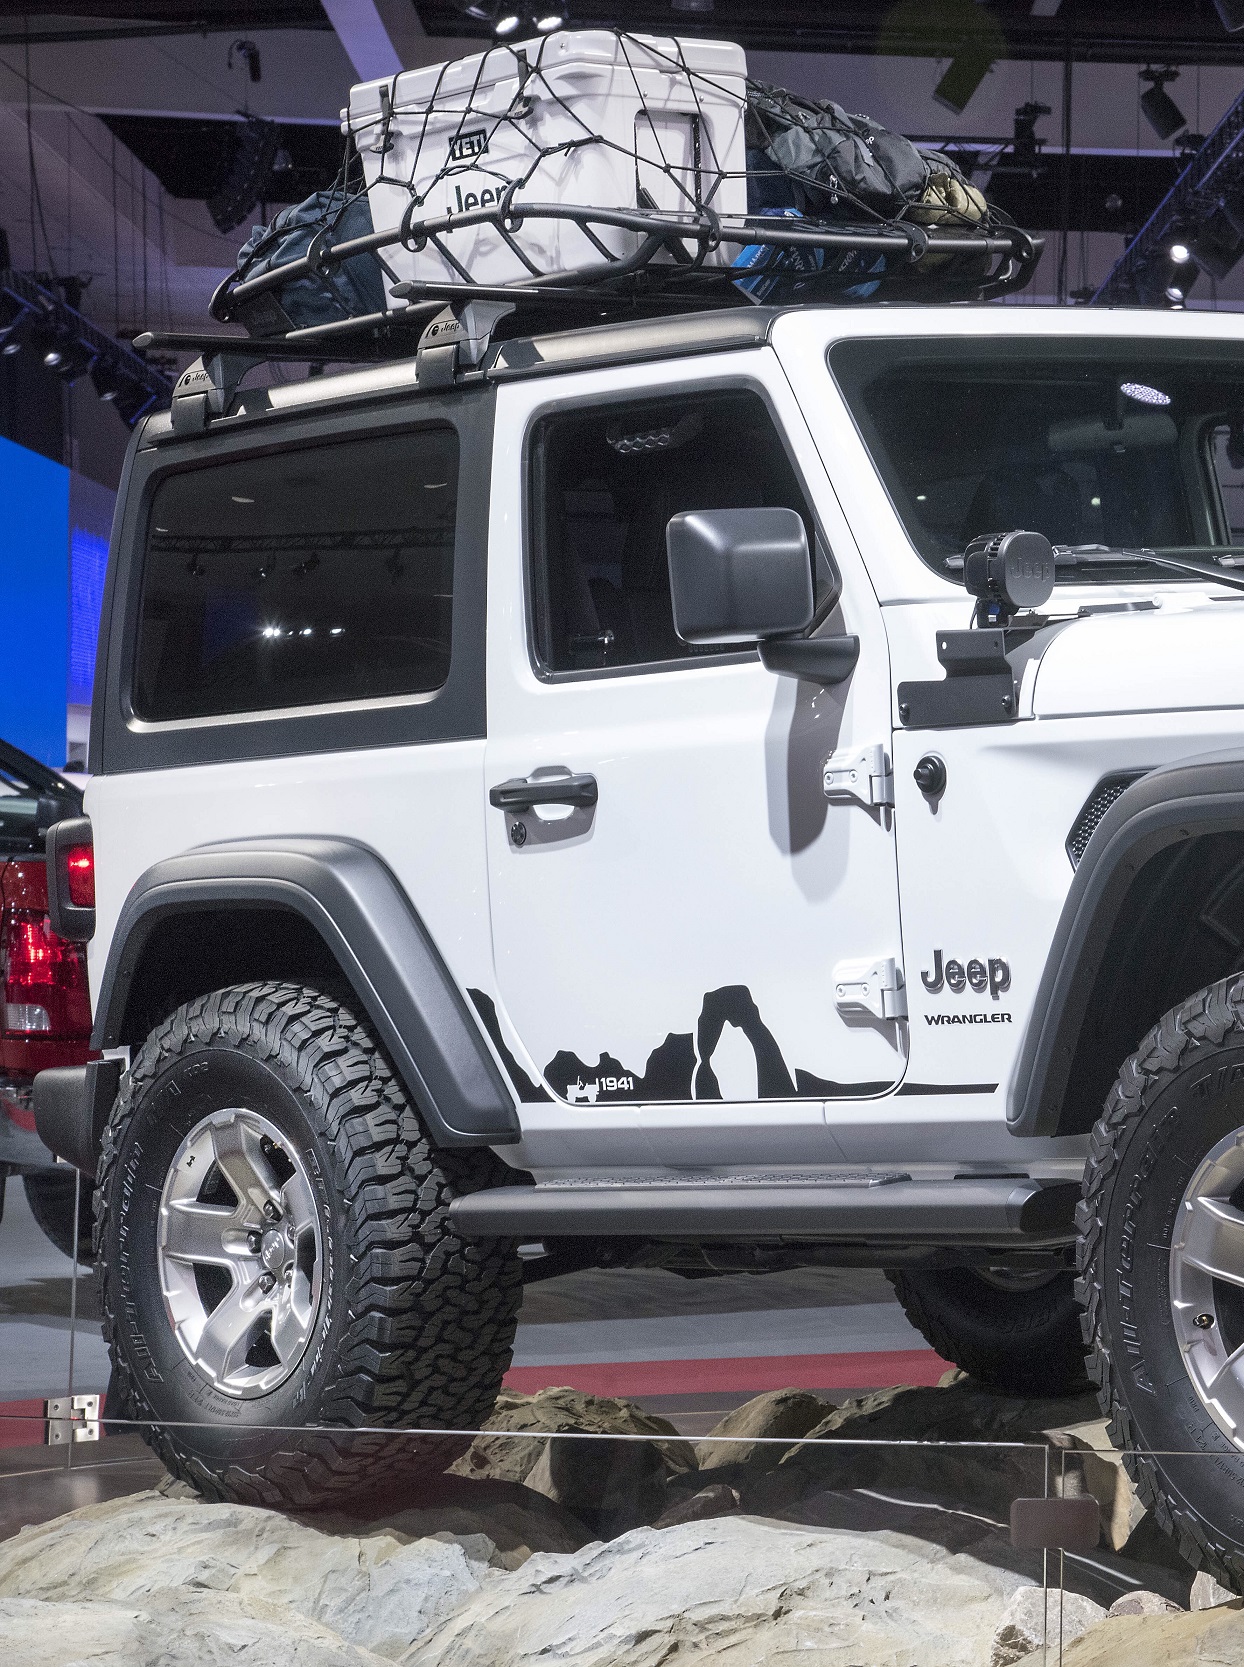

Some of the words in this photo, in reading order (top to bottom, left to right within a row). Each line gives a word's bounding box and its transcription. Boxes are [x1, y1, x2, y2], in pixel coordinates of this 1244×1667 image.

[1010, 557, 1051, 582] Jeep
[921, 949, 1011, 998] Jeep
[924, 1013, 1013, 1025] WRANGLER
[600, 1077, 634, 1090] 1941
